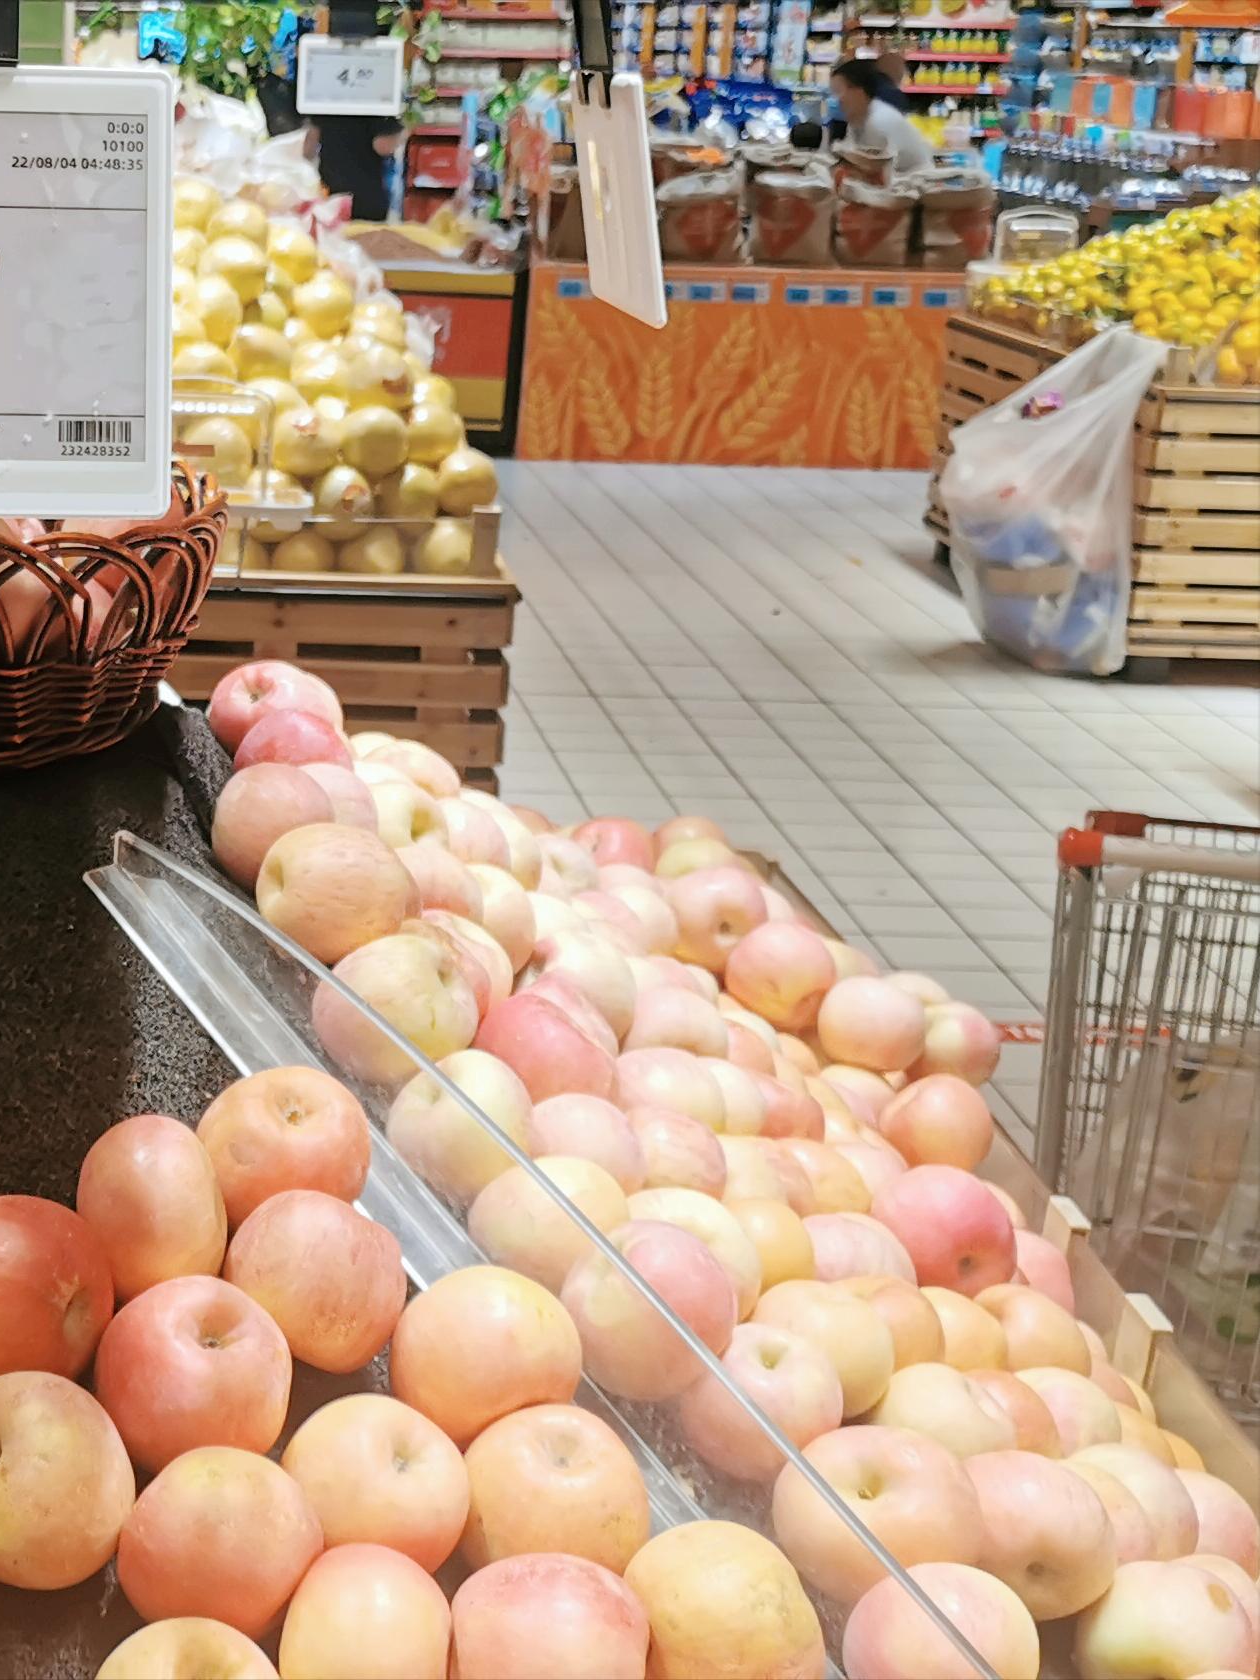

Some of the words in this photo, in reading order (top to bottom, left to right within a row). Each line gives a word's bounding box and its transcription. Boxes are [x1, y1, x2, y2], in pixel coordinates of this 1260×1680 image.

[107, 121, 144, 134] 0:0:0
[102, 140, 144, 152] 10100
[11, 156, 77, 169] 22/08/04
[81, 157, 143, 170] 04:48:35
[60, 444, 131, 457] 232428352
